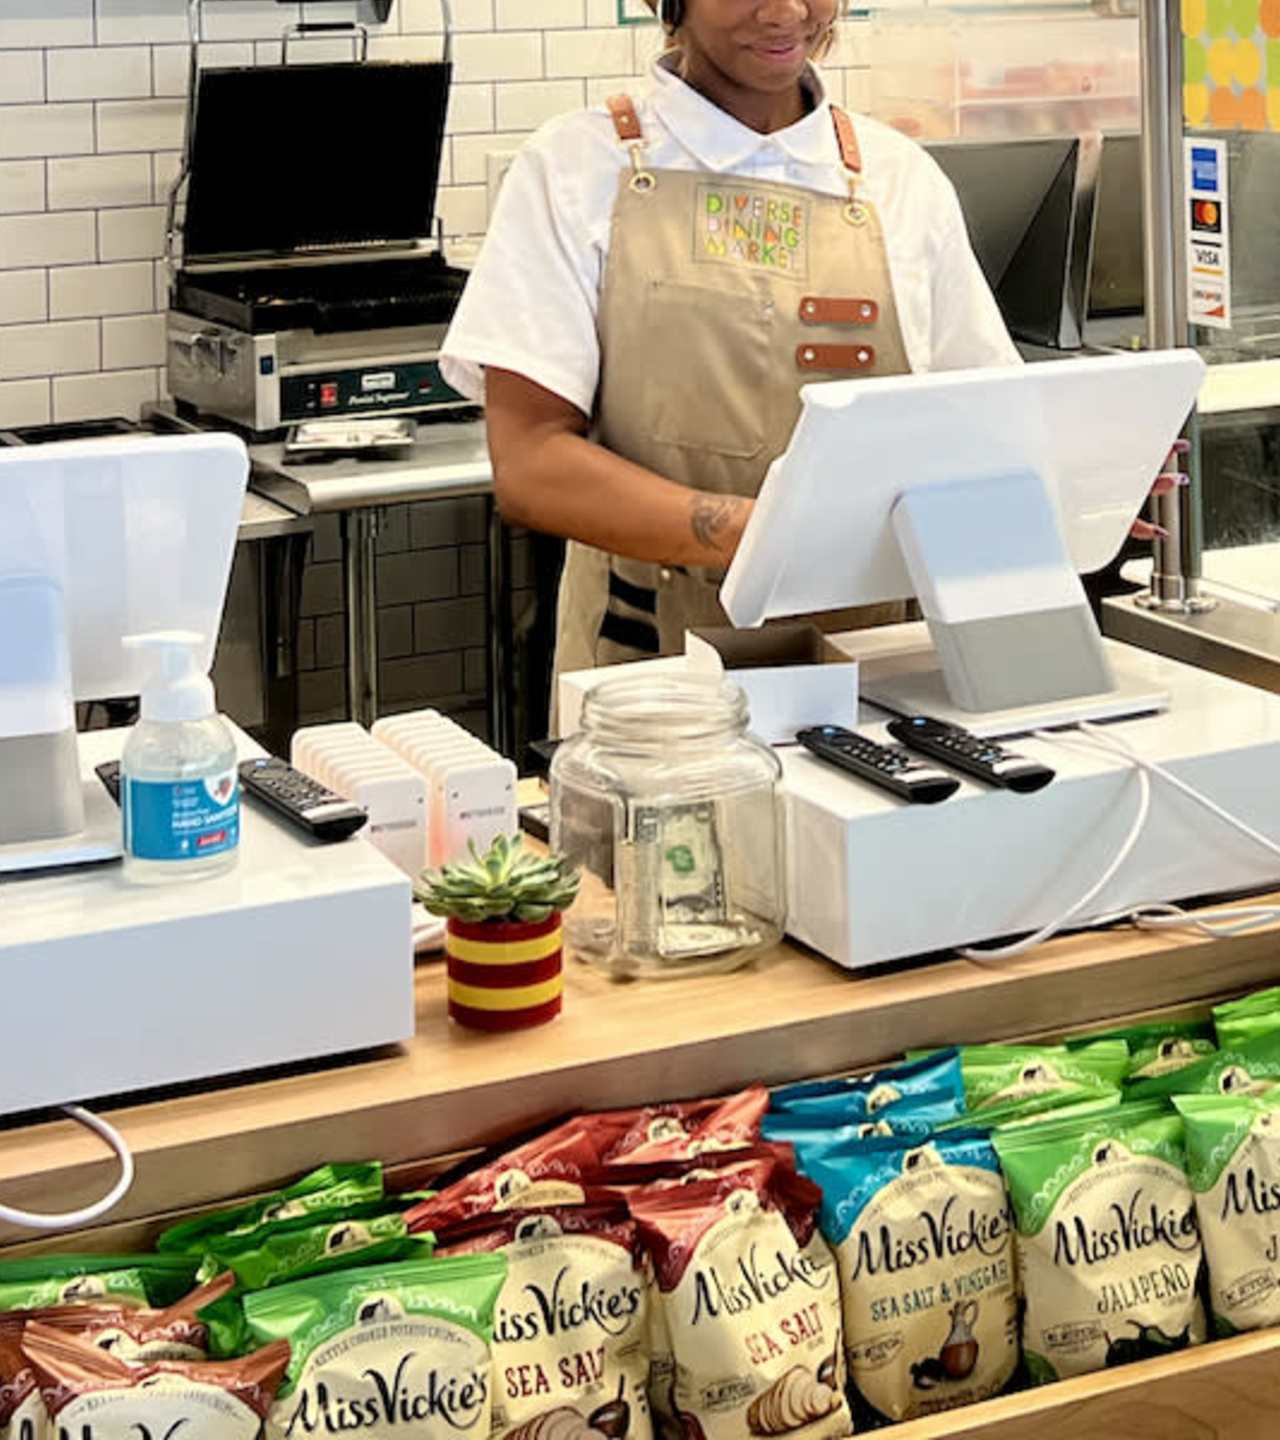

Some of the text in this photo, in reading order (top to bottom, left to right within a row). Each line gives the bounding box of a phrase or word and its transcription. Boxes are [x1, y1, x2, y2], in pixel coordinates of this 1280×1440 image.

[706, 191, 802, 229] DIVERSE
[707, 216, 800, 250] DINING
[1195, 249, 1220, 265] VISA
[870, 1259, 1010, 1323] SEA SALT & VINEGAR
[1097, 1263, 1191, 1314] JALAPEÑO
[492, 1308, 540, 1345] iss
[744, 1301, 824, 1365] SEA SALT
[505, 1363, 552, 1401] SEA
